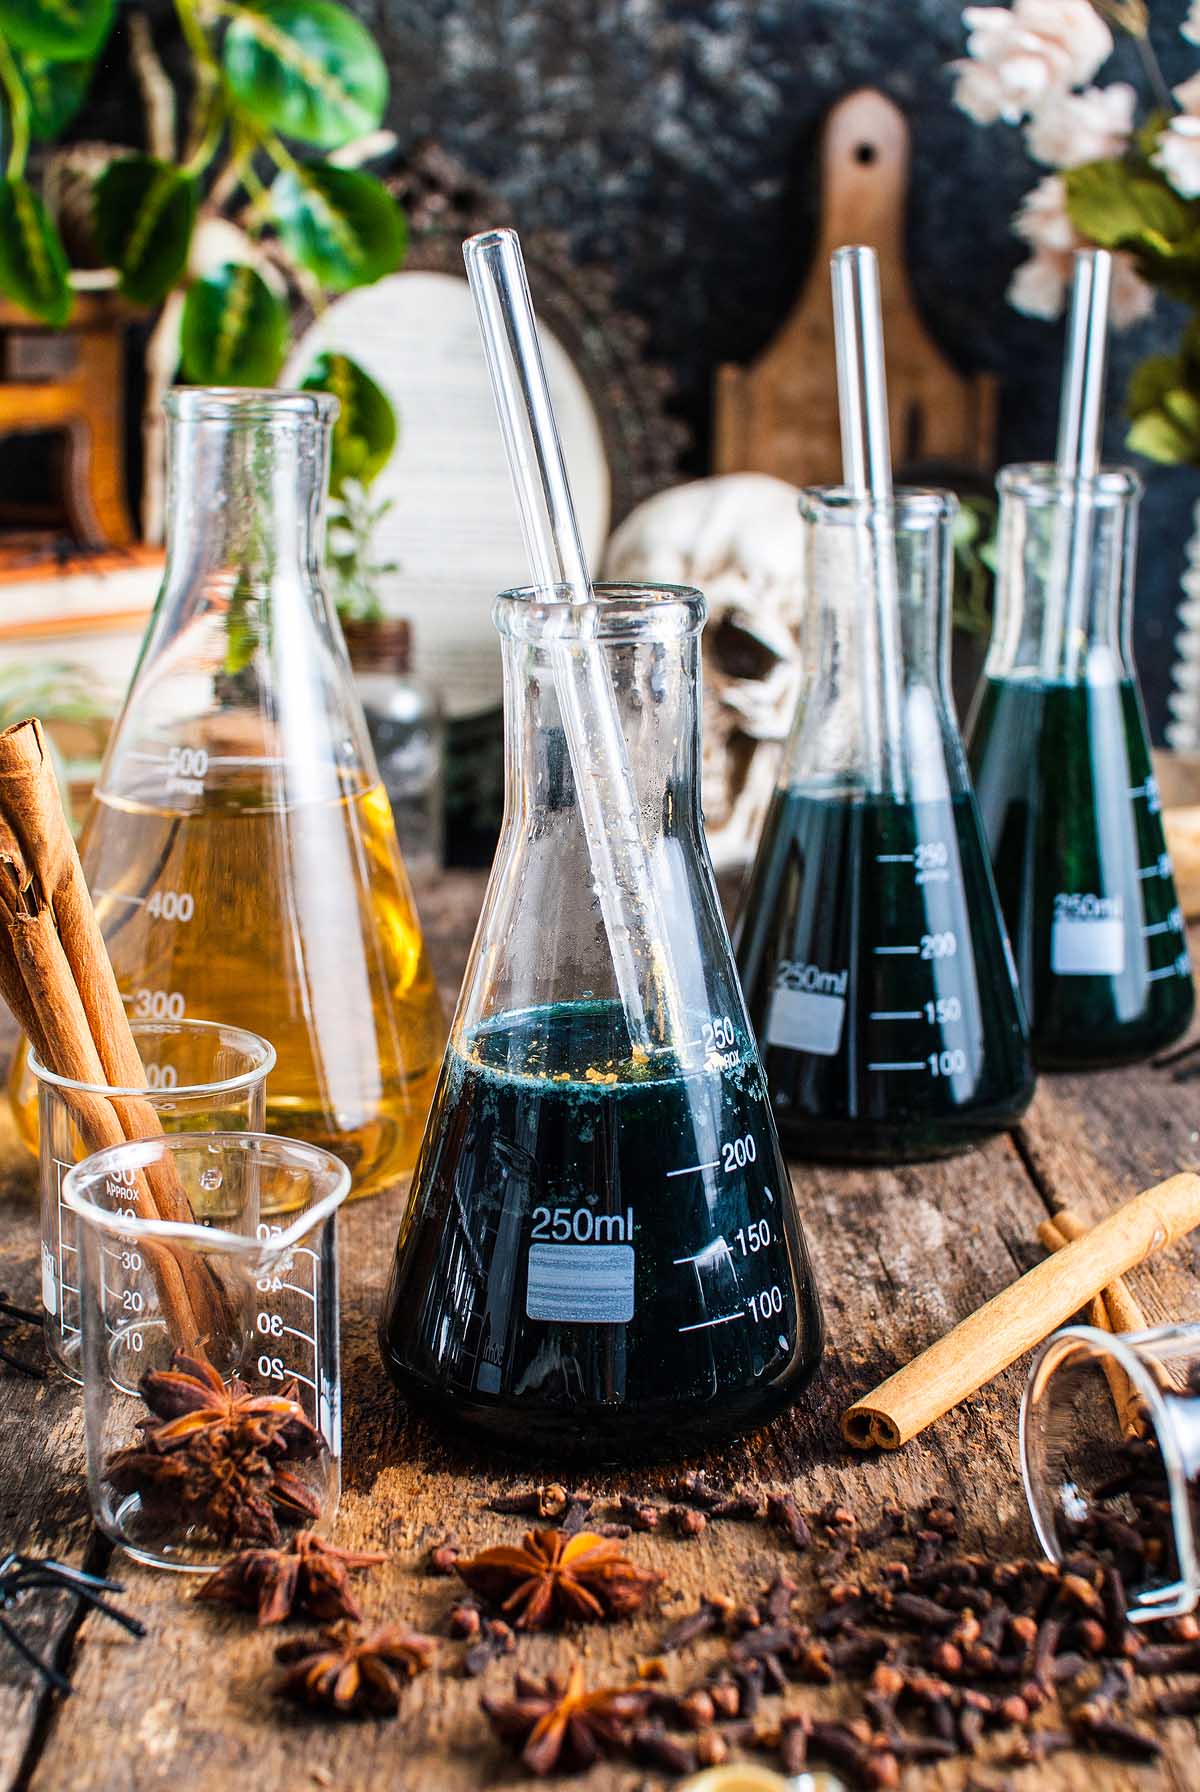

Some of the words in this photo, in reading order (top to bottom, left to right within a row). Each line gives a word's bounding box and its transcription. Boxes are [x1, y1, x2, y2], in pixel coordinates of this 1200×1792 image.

[168, 748, 208, 777] 500
[914, 842, 947, 869] 250
[147, 891, 194, 922] 400
[920, 931, 956, 959] 200
[776, 960, 848, 993] 250ml
[135, 992, 185, 1020] 300
[924, 998, 961, 1025] 150
[702, 1016, 734, 1052] 250
[147, 1064, 177, 1088] 00
[928, 1050, 965, 1077] 100
[722, 1135, 756, 1173] 200
[106, 1180, 139, 1201] APPROX
[531, 1207, 633, 1241] 250ml
[736, 1219, 770, 1256] 150
[121, 1251, 142, 1271] 30
[122, 1291, 143, 1312] 20
[748, 1286, 782, 1323] 100
[124, 1330, 143, 1351] 10
